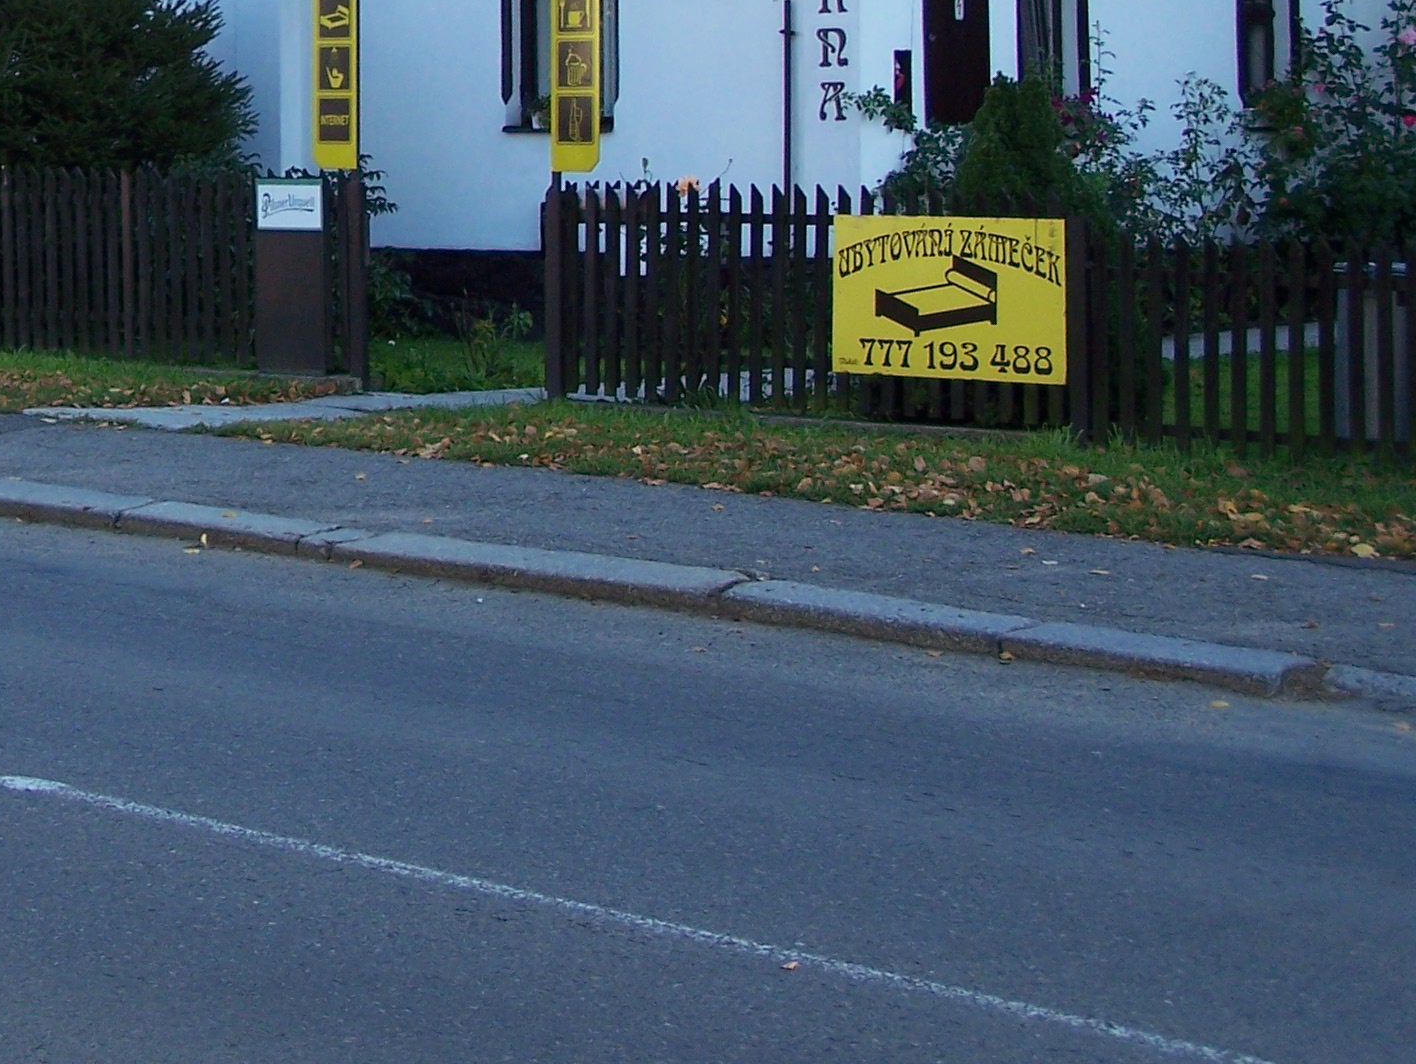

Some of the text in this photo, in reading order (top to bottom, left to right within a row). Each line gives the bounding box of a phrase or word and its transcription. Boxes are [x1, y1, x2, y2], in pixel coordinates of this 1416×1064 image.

[838, 222, 1062, 287] UBYTOVÁNÍ ZÁMEČEK
[859, 338, 1053, 376] 777 193 488
